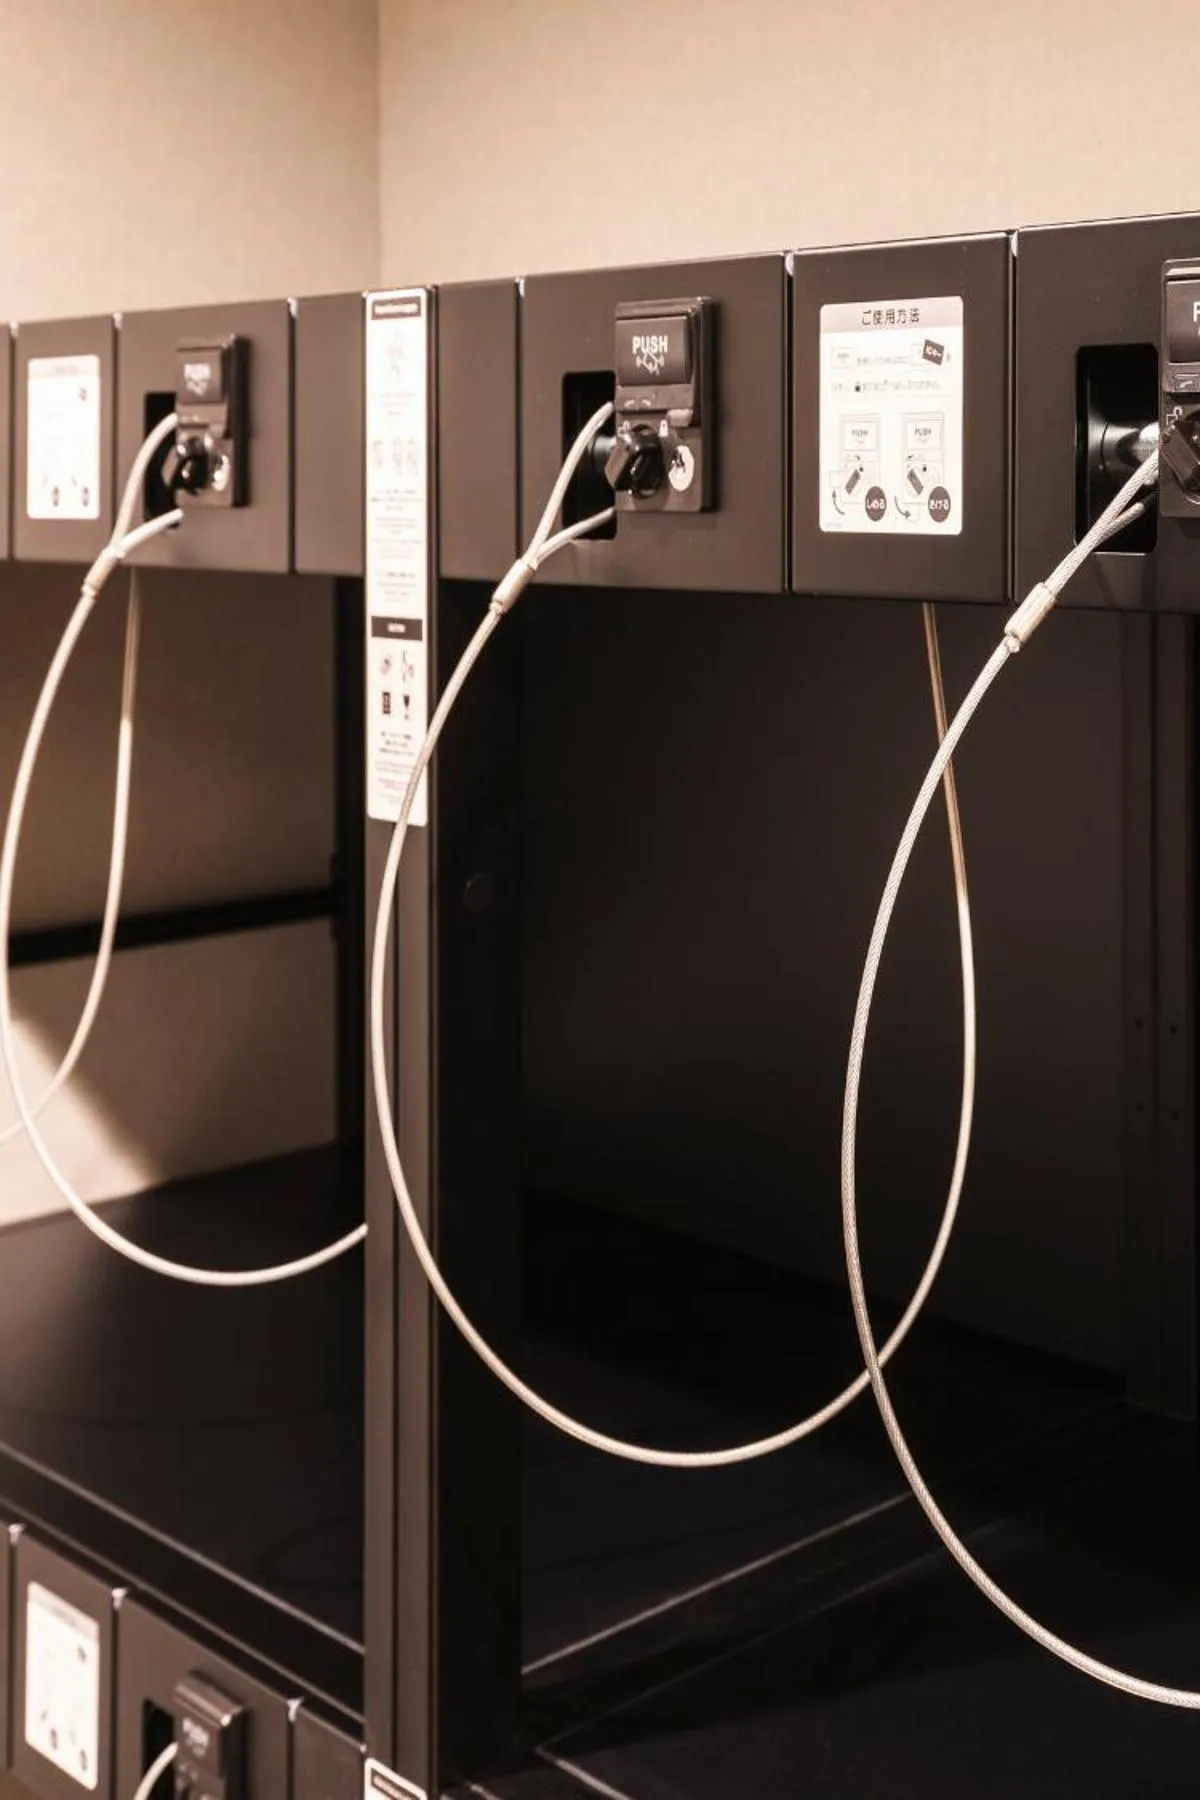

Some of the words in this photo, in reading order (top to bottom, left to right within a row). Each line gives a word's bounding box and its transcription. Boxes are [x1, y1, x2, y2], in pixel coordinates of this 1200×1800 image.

[861, 309, 920, 325] ご使用方法
[632, 335, 668, 354] PUSH
